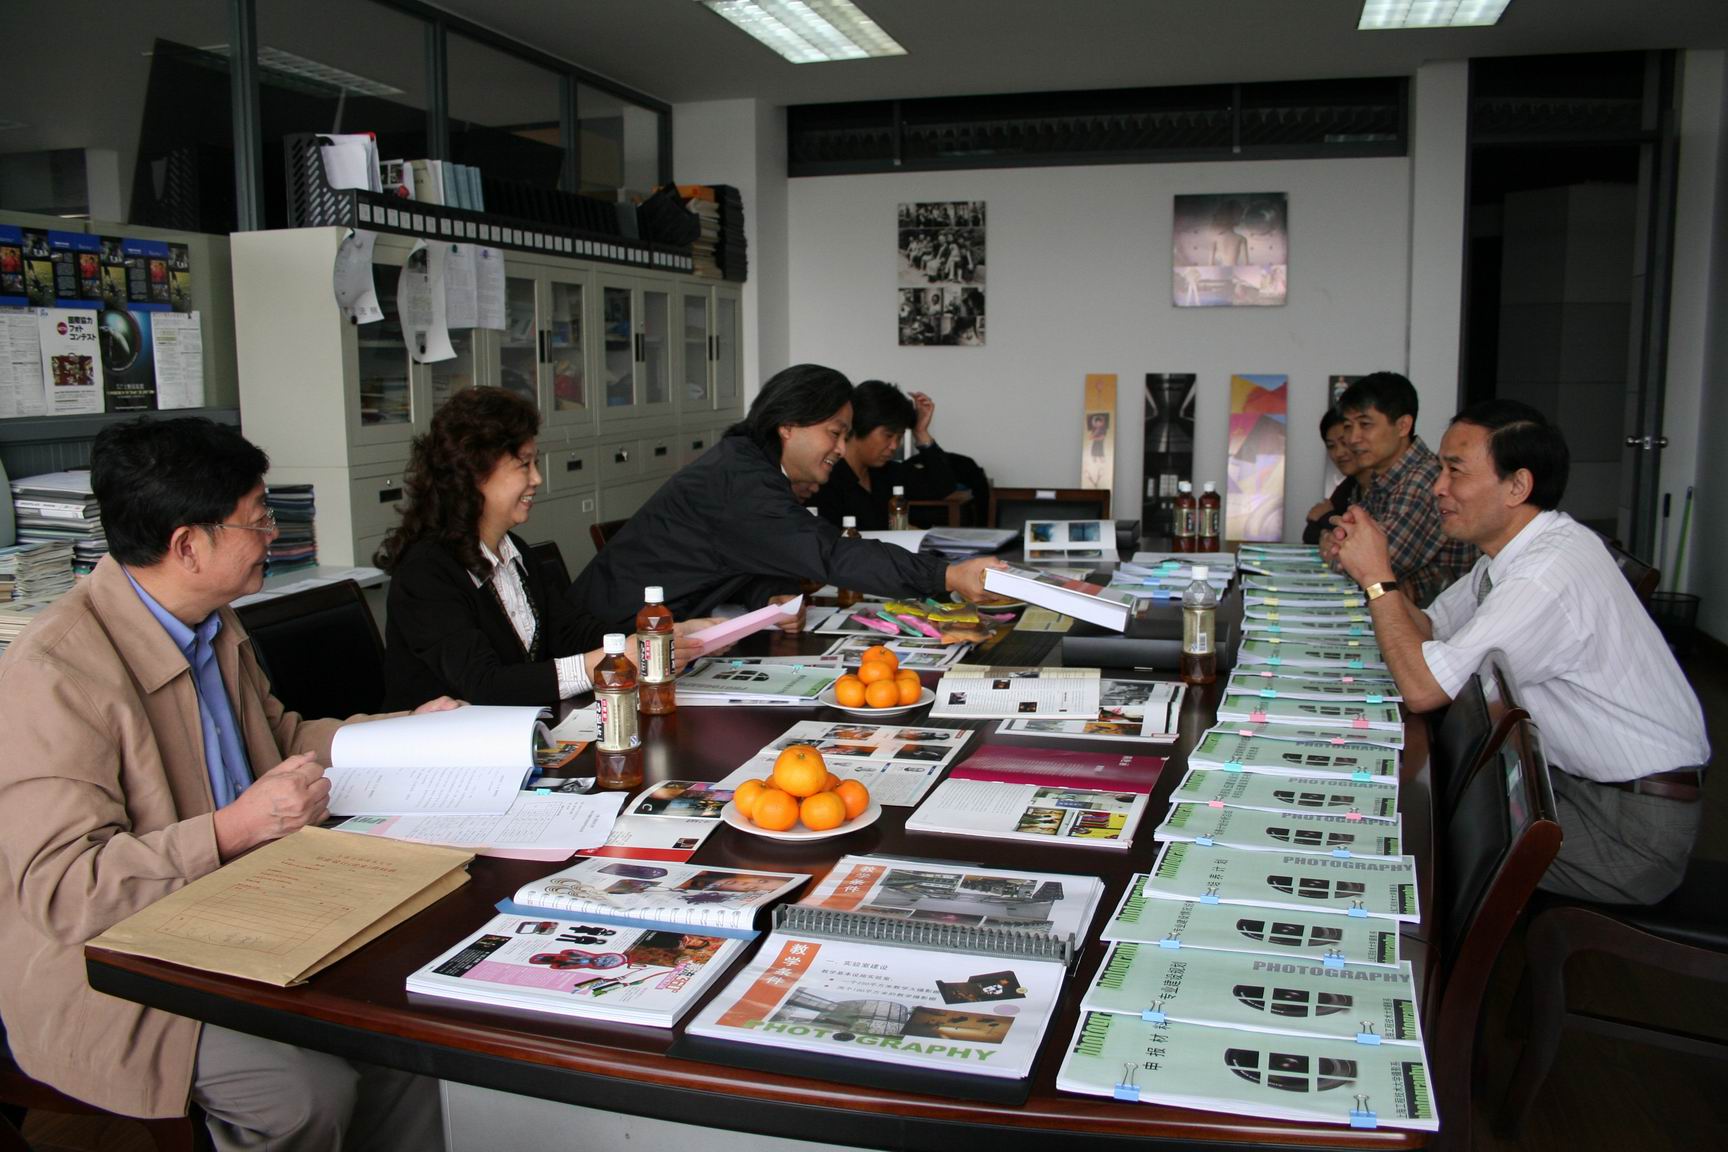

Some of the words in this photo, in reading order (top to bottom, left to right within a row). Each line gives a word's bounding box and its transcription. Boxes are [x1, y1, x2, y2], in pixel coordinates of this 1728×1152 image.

[69, 333, 97, 341] コンテスト
[1284, 856, 1413, 872] PHOTOGRAPHY
[767, 943, 809, 985] 教学条件
[1252, 960, 1411, 984] PHOTOGRAPHY
